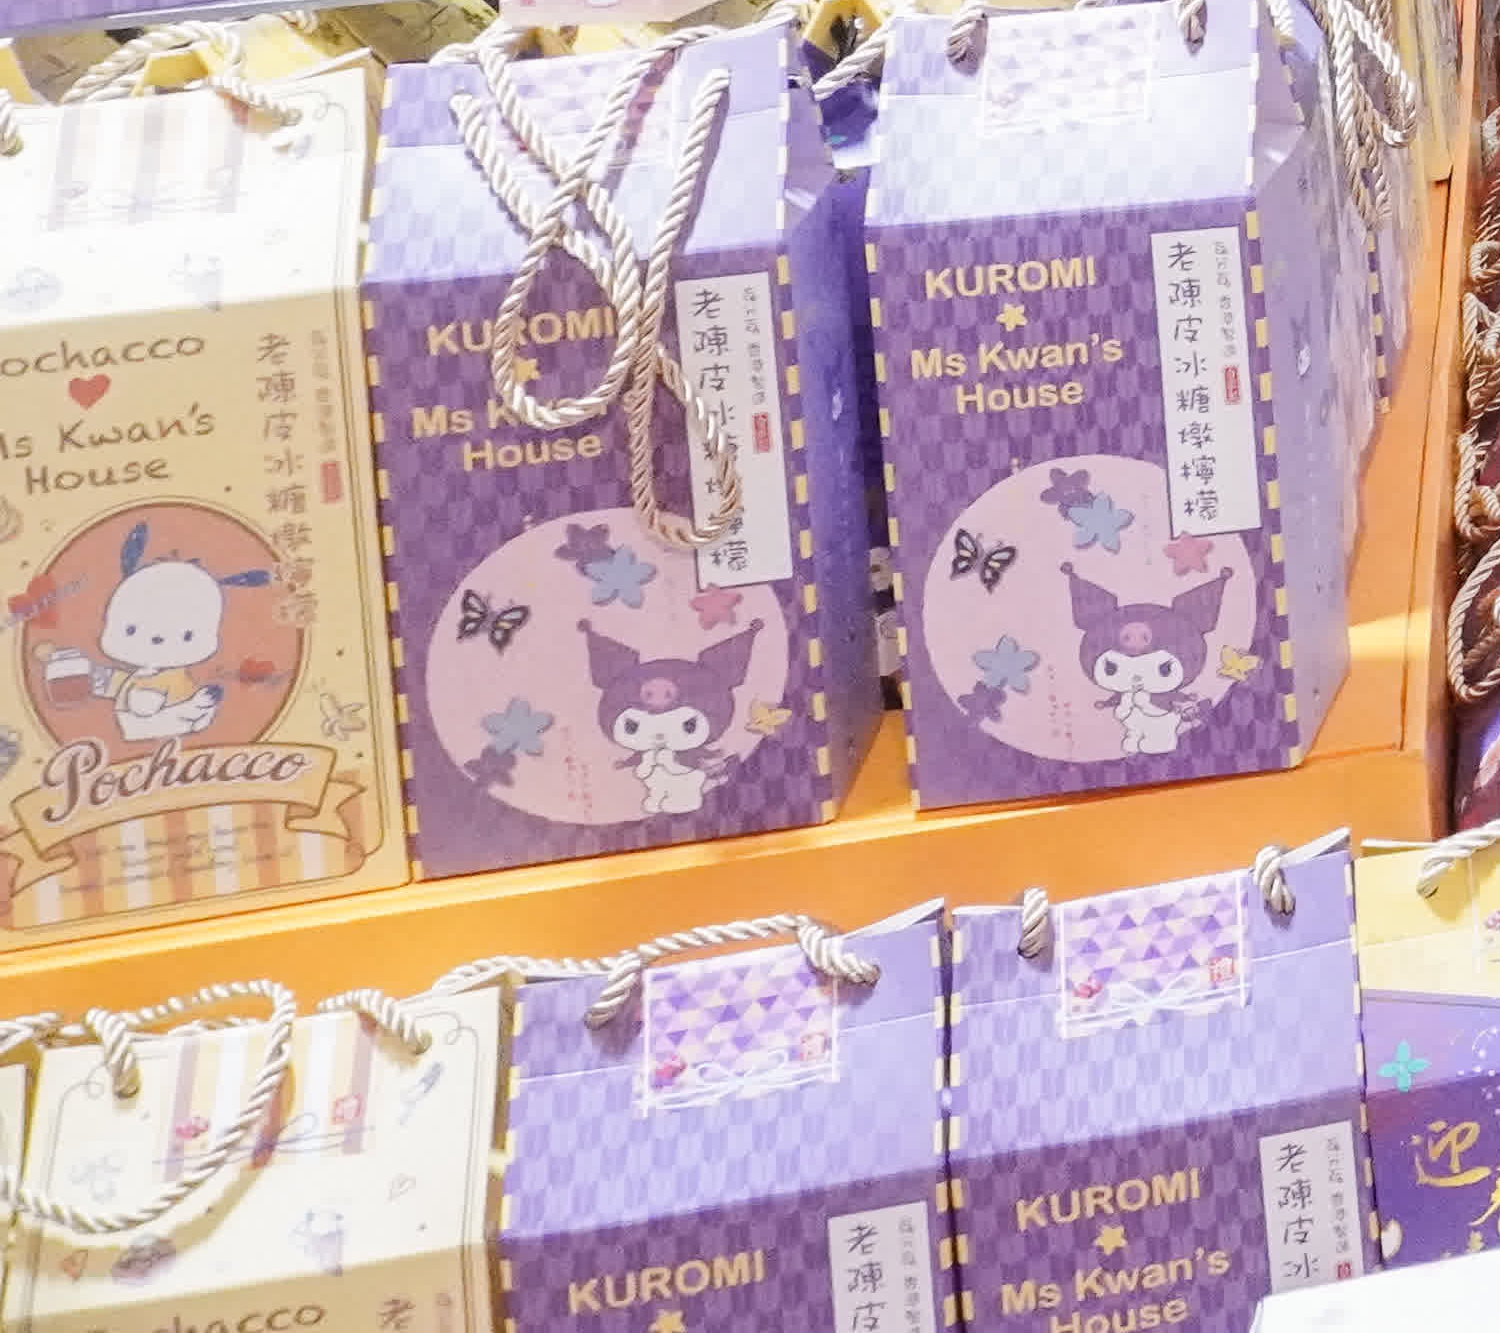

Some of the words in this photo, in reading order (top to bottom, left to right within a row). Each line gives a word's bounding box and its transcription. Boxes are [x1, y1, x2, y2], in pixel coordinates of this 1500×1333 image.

[925, 255, 1097, 299] KUROMI
[911, 346, 971, 380] Ms
[978, 331, 1125, 376] Kwan's
[956, 379, 1085, 416] House
[411, 403, 475, 438] Ms
[462, 433, 605, 472] House
[25, 457, 170, 496] House
[43, 738, 306, 824] Pochacco
[1015, 1167, 1202, 1231] KUROMI
[568, 1247, 767, 1316] KUROMI
[1001, 1279, 1062, 1315] Ms
